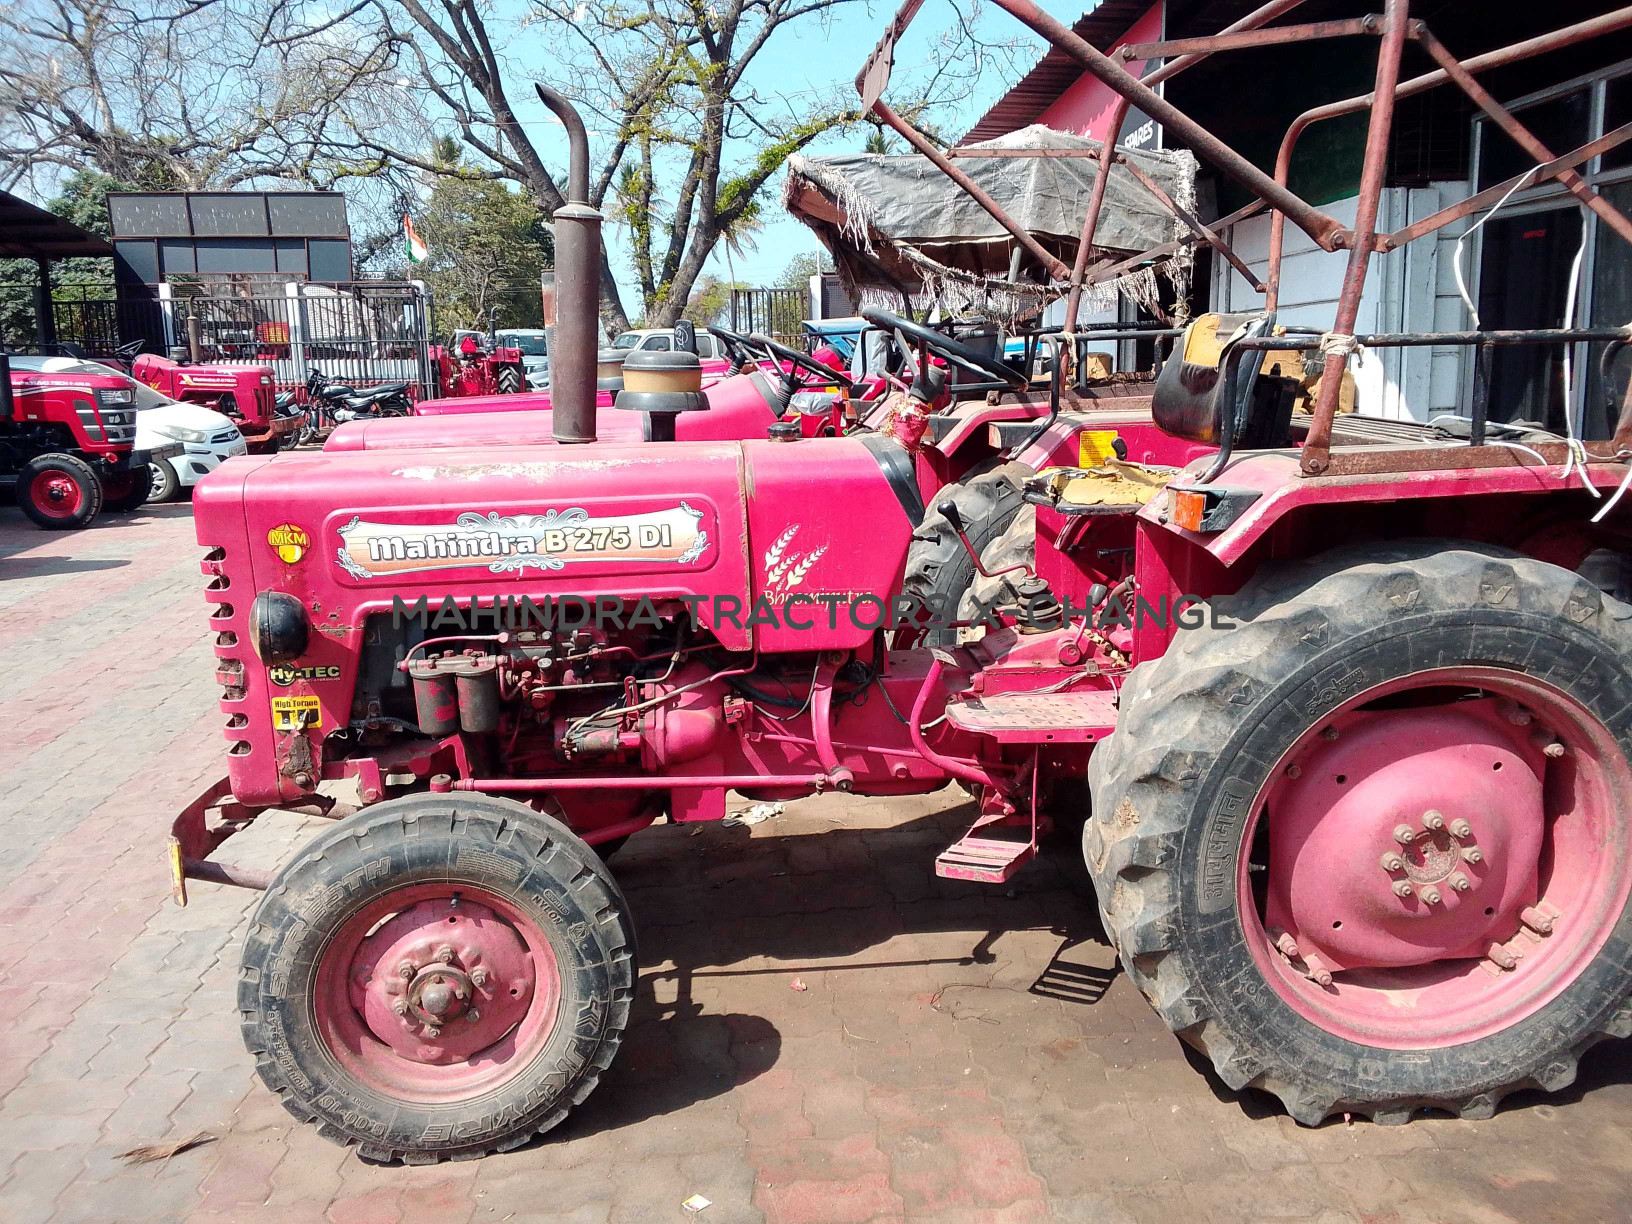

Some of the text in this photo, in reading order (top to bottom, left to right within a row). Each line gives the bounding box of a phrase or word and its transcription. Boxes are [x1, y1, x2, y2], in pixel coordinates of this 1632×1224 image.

[1125, 119, 1153, 149] SPARES
[270, 531, 306, 545] MKM
[368, 523, 672, 561] Mahindra B 275 DI
[270, 666, 340, 682] Hy-TEC
[275, 699, 318, 708] High Torque
[532, 895, 563, 926] NYLON
